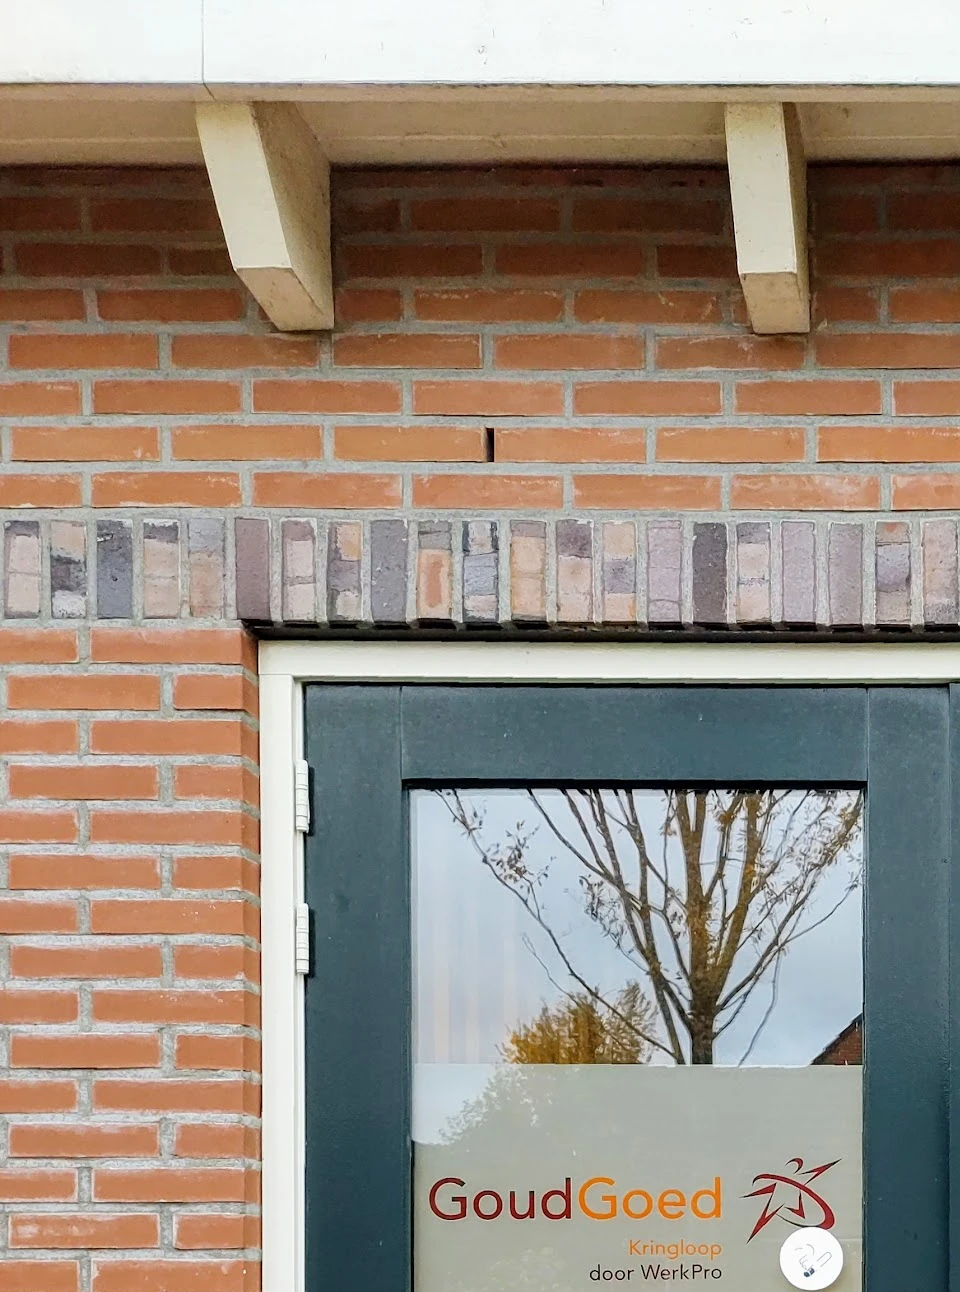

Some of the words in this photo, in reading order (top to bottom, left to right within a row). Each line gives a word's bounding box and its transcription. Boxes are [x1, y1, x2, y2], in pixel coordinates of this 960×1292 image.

[428, 1176, 722, 1221] GoudGoed
[628, 1239, 722, 1261] Kringloop
[589, 1263, 635, 1281] door
[641, 1263, 723, 1281] WerkPro
